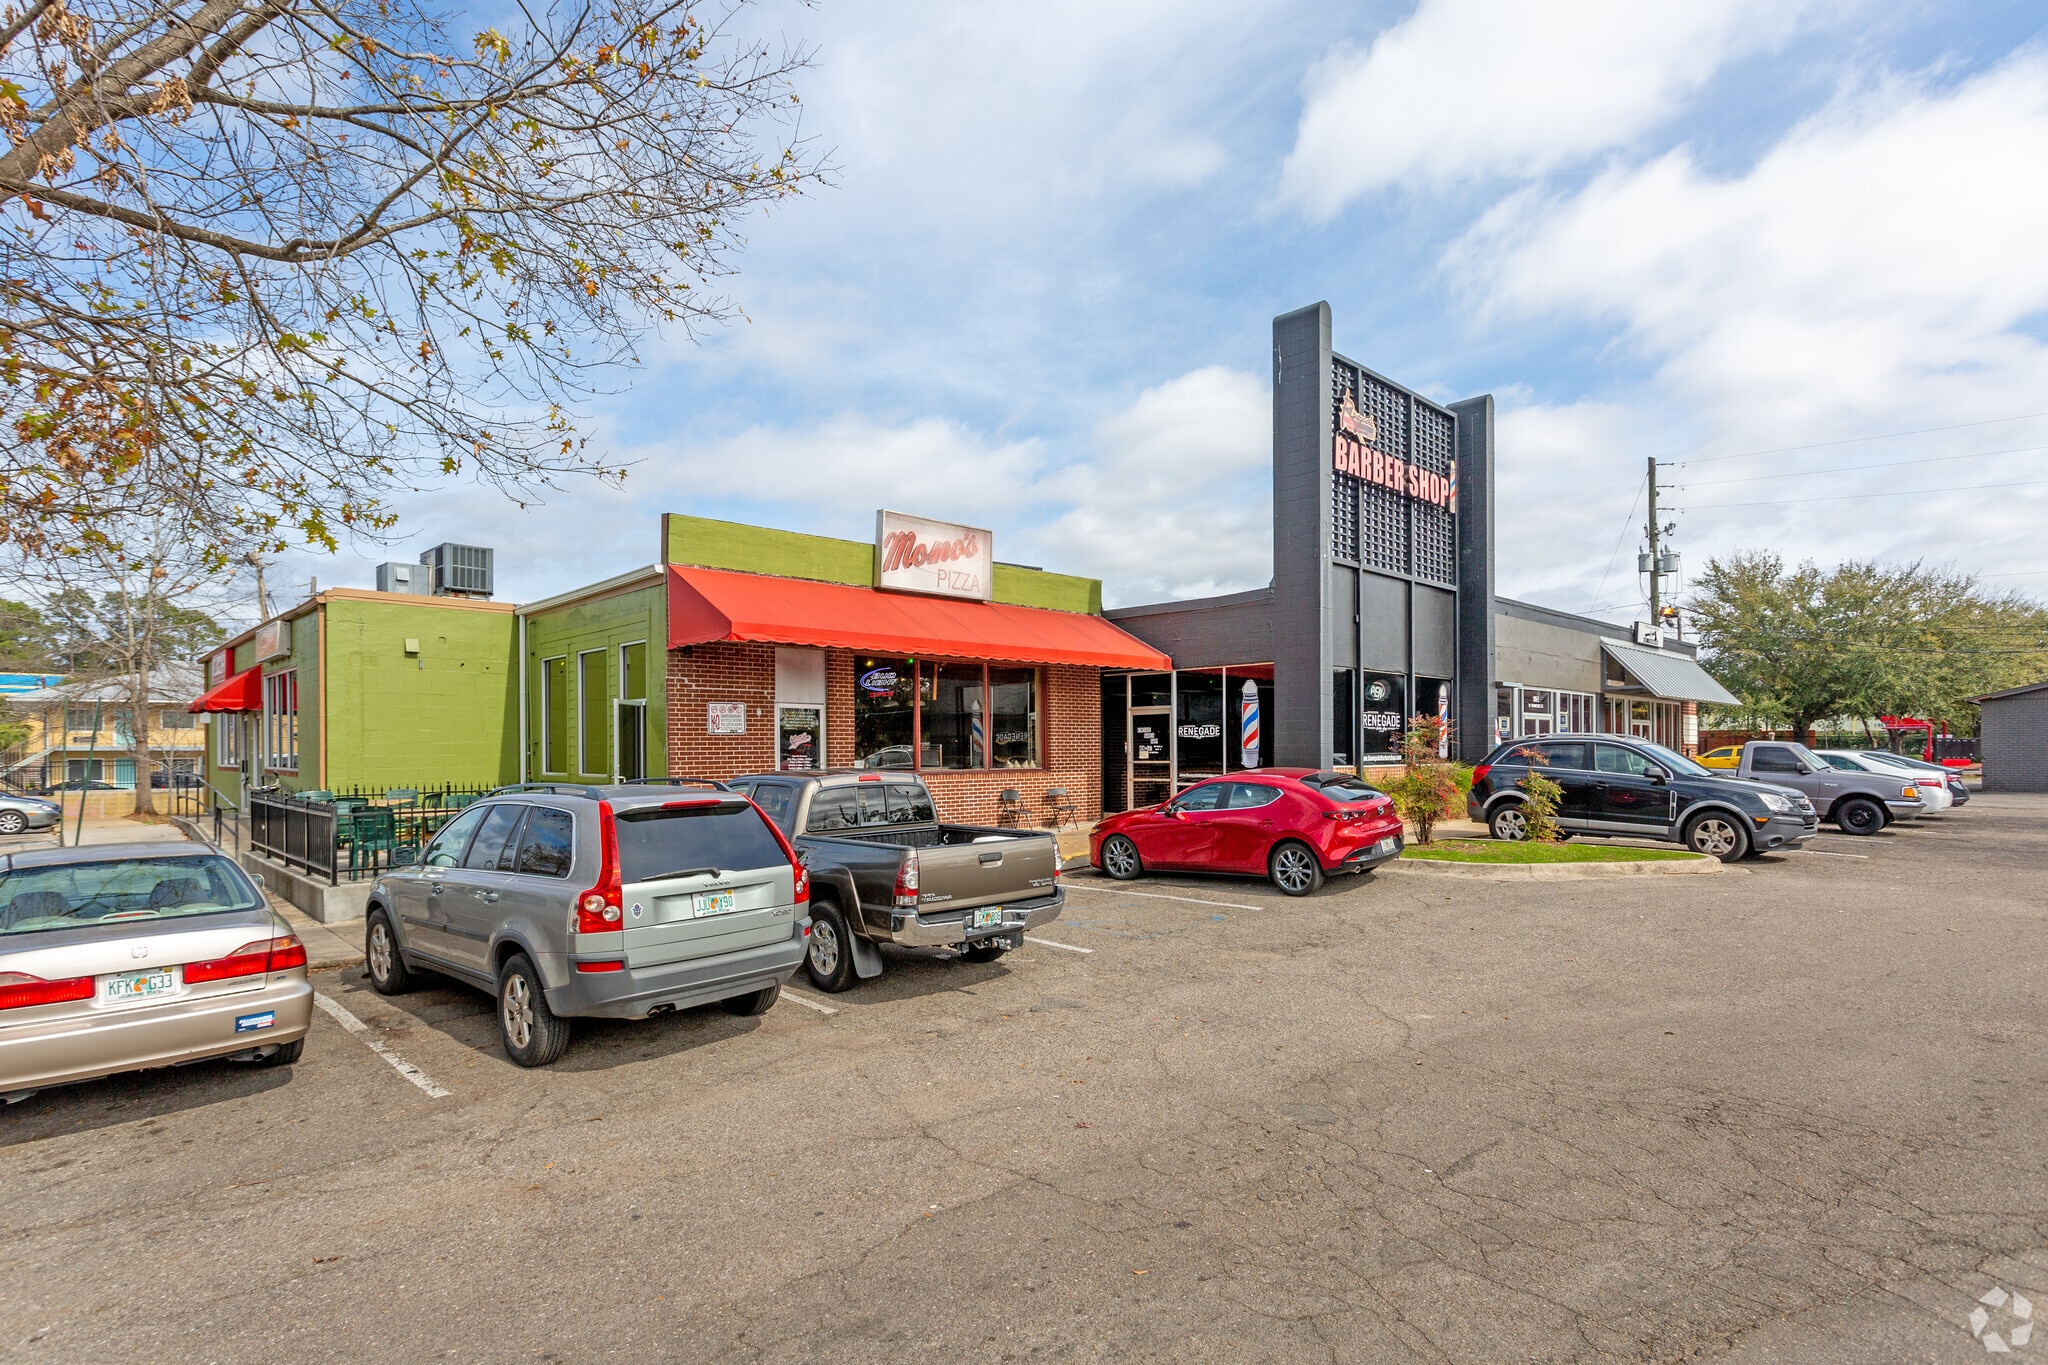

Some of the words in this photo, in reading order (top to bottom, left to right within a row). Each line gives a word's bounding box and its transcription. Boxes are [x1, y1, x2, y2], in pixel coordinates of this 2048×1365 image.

[1335, 434, 1404, 492] BARBER
[1408, 464, 1450, 507] SHOP
[882, 530, 979, 572] Momo's
[936, 568, 981, 593] PIZZA
[1178, 726, 1220, 736] RENEGADE
[1363, 714, 1401, 728] RENEGADE
[108, 980, 134, 995] KFK
[149, 973, 173, 991] G33
